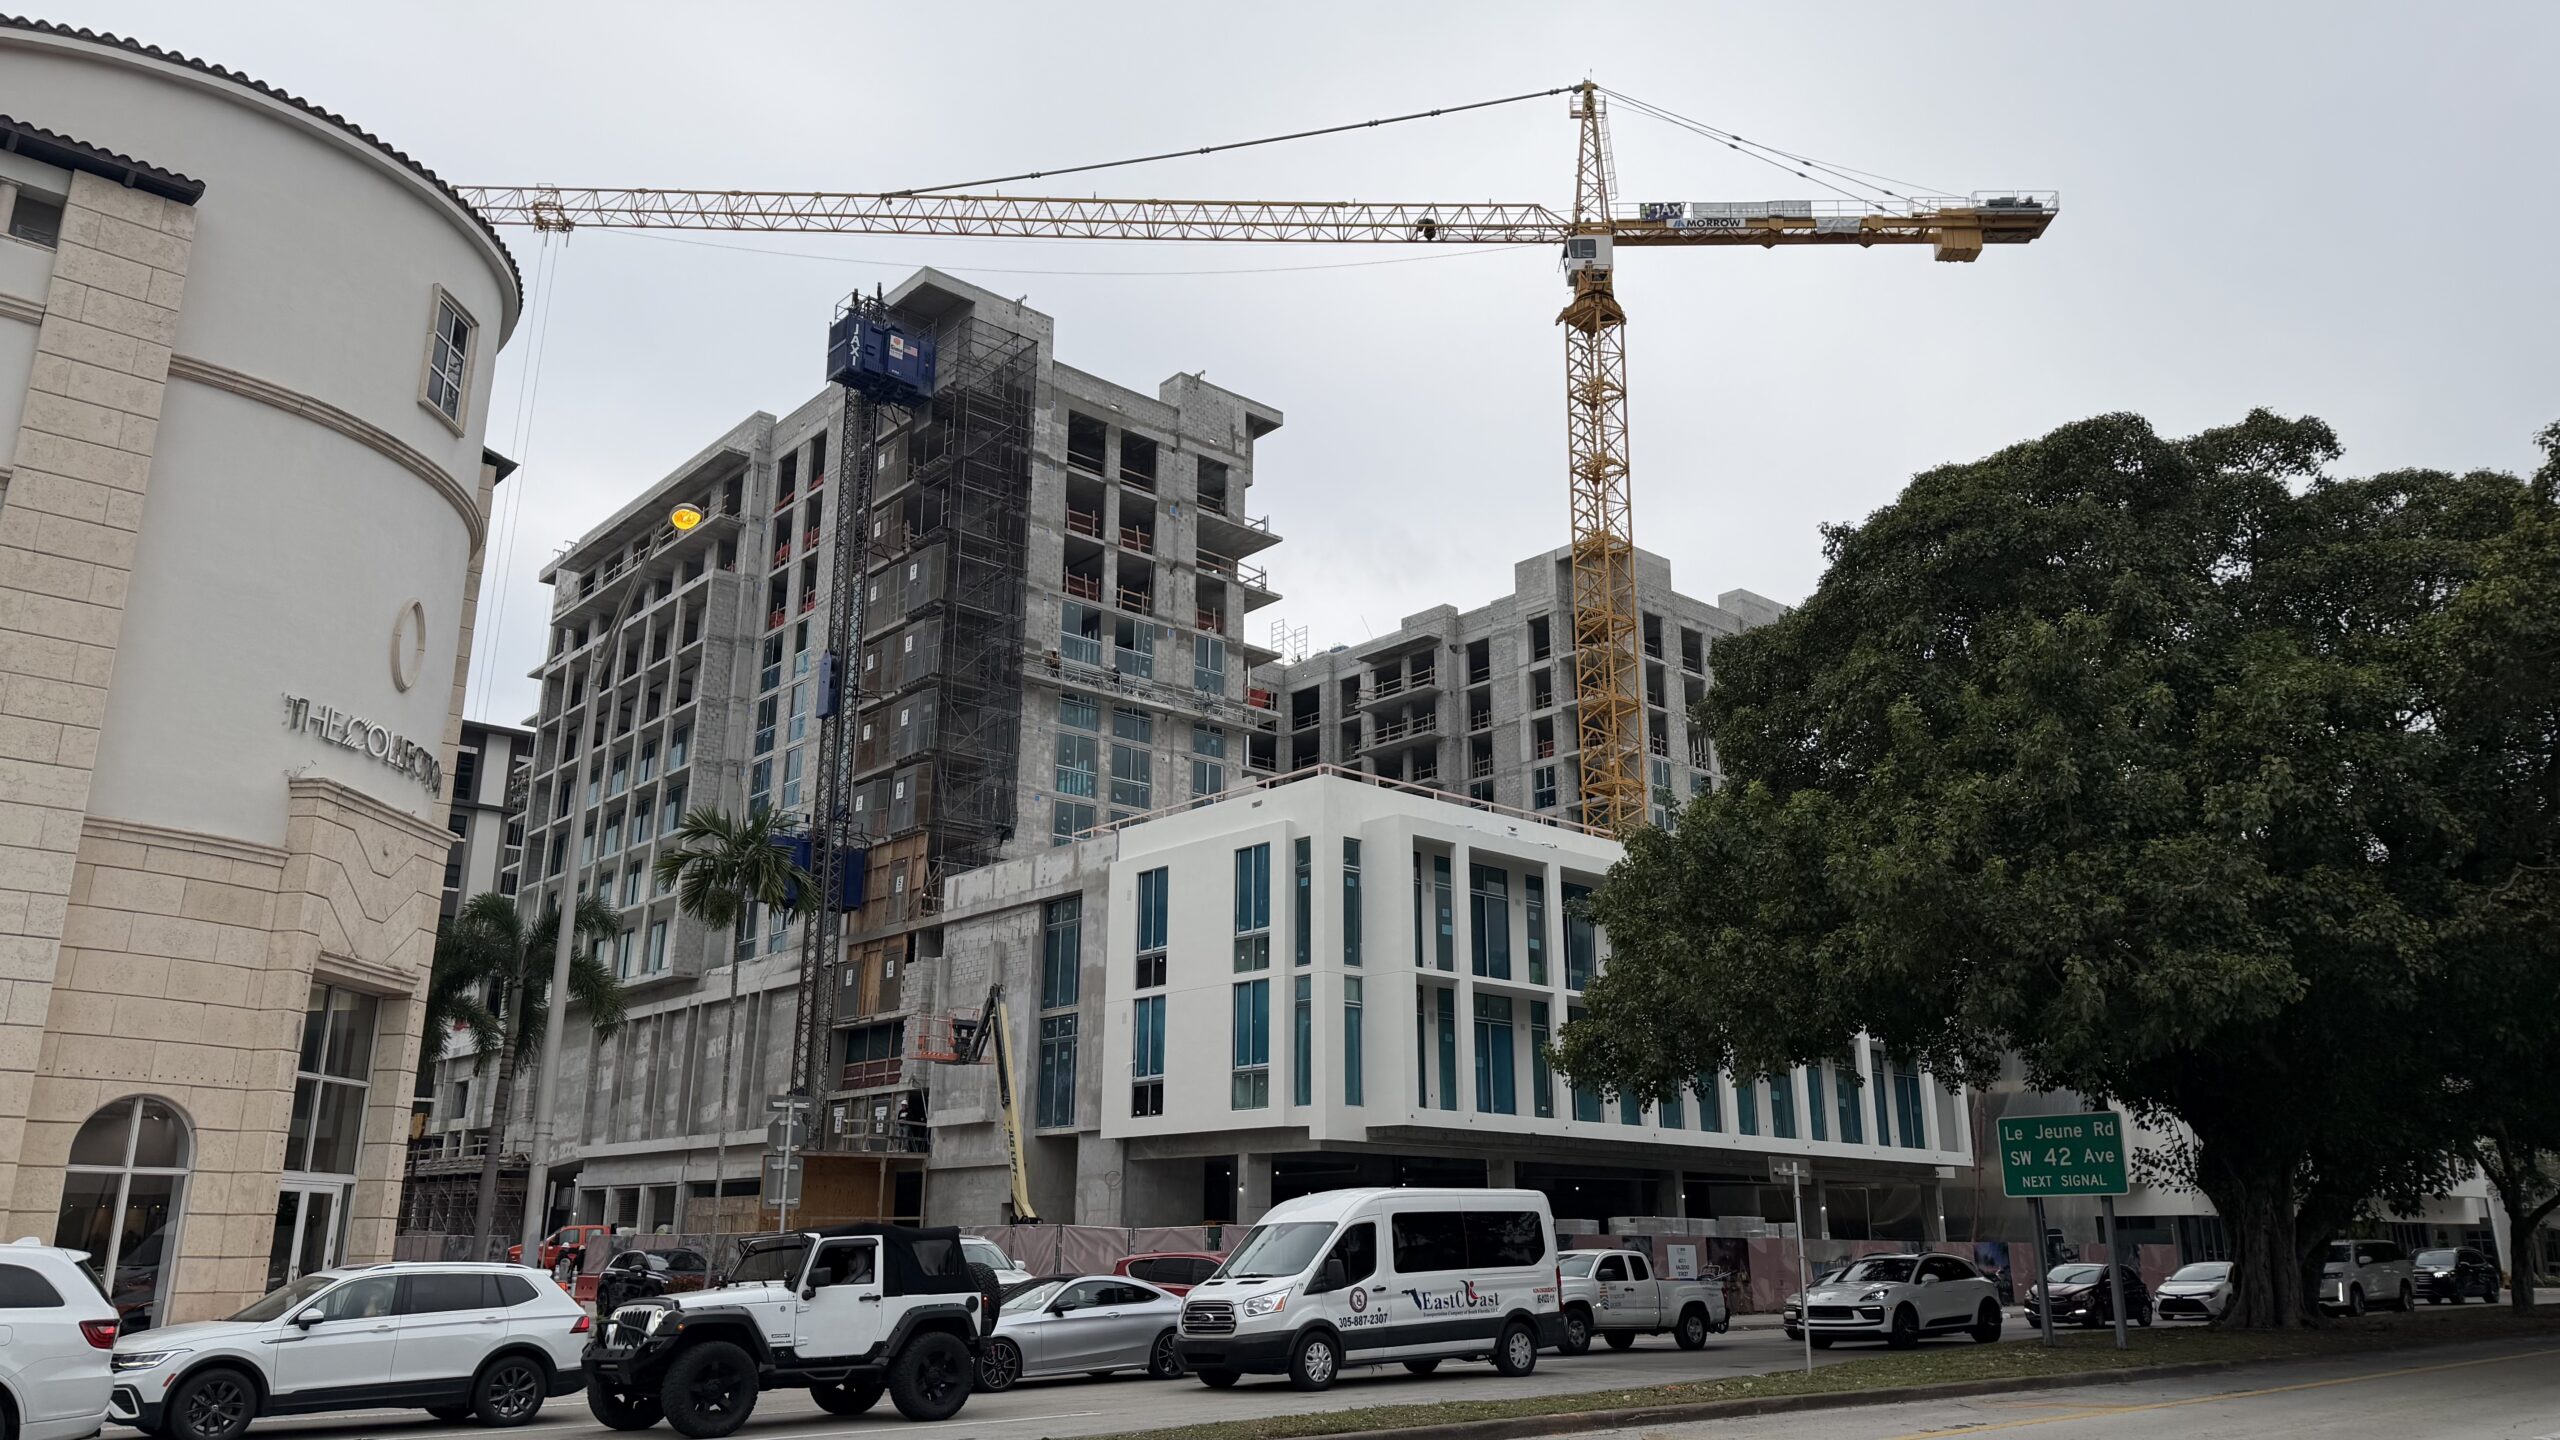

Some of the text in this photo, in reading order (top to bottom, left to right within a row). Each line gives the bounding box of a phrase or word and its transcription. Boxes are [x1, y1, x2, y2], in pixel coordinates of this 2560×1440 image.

[1687, 219, 1740, 227] MORROW
[850, 323, 860, 366] JAXI
[283, 693, 345, 742] THE
[2005, 1121, 2115, 1141] Le Jeune Rd
[2010, 1147, 2115, 1166] SW 42 Ave
[2022, 1174, 2108, 1188] NEXT SIGNAL
[1339, 1313, 1388, 1328] 305-887-2307
